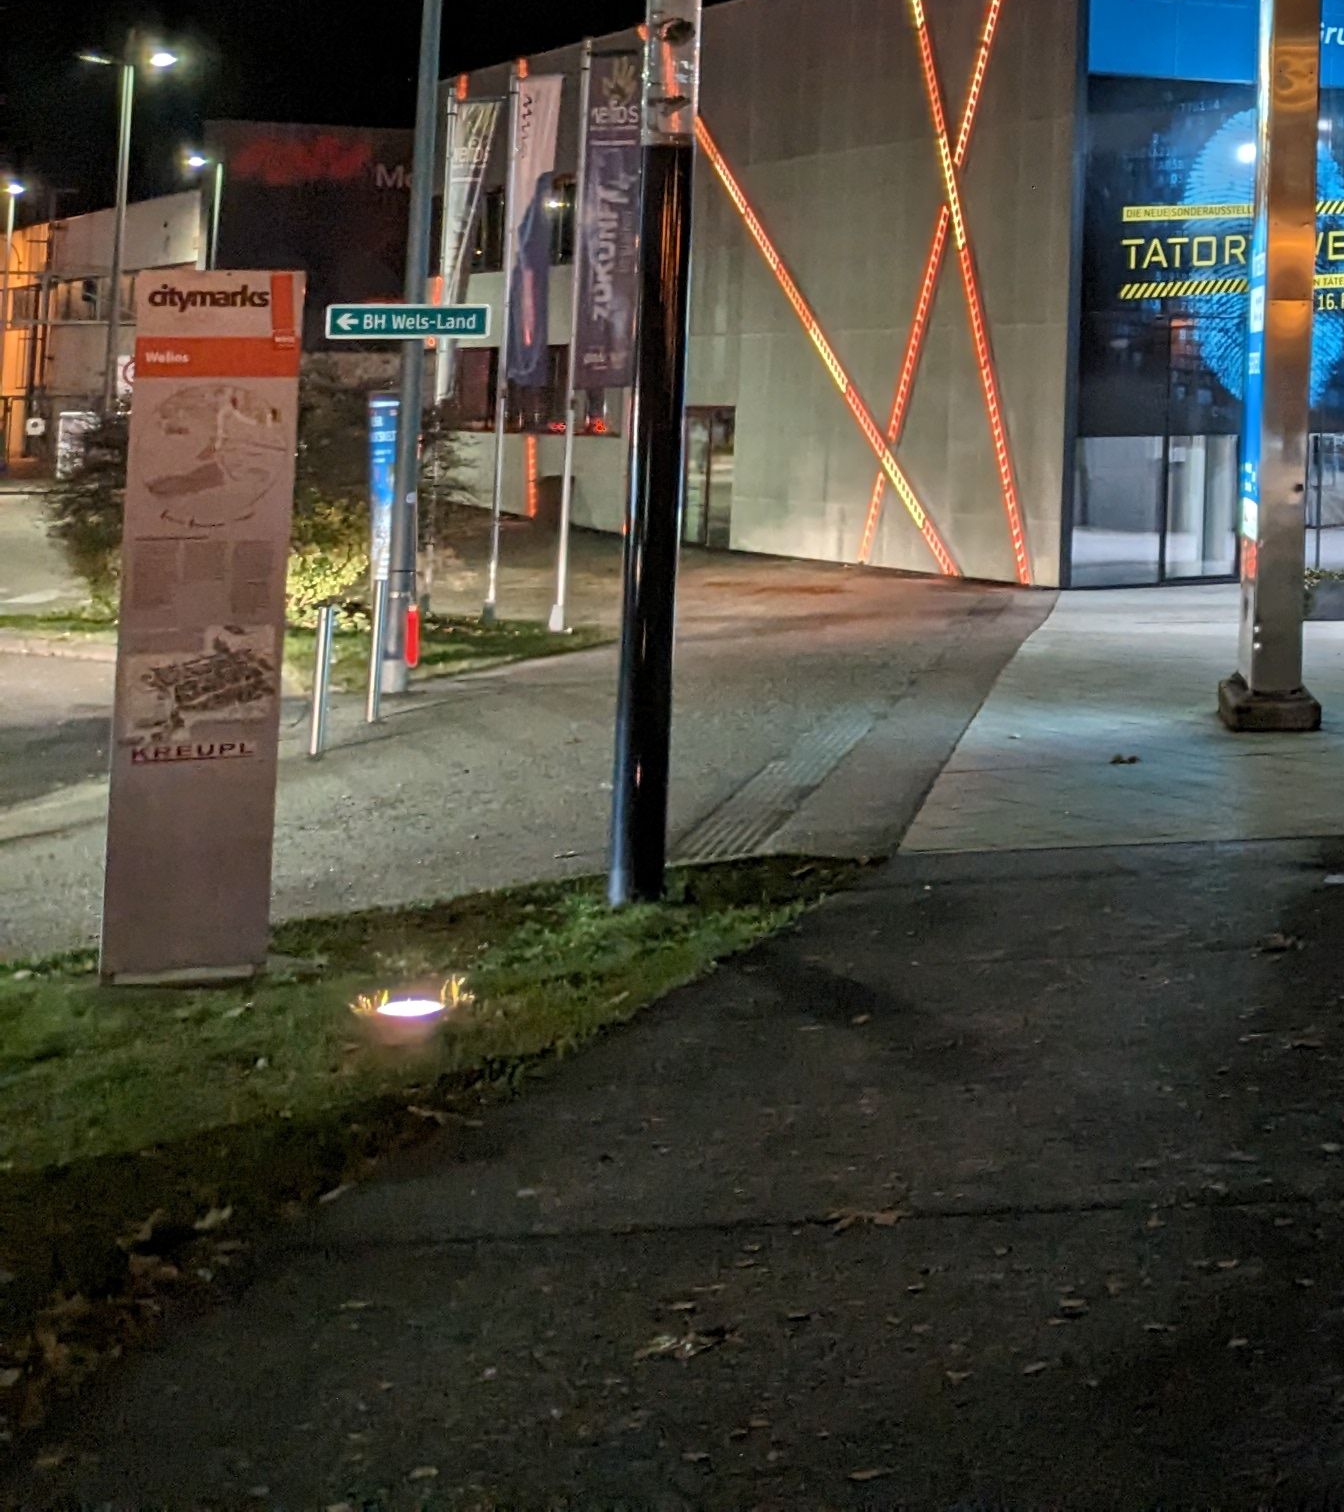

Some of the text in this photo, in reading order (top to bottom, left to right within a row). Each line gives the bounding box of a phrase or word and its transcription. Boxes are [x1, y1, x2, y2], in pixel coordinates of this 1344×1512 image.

[1126, 209, 1142, 218] DIE
[1144, 208, 1169, 218] NEUE
[149, 284, 269, 312] citymarks
[1318, 292, 1338, 310] 16.
[363, 314, 476, 329] BH Wels-Land
